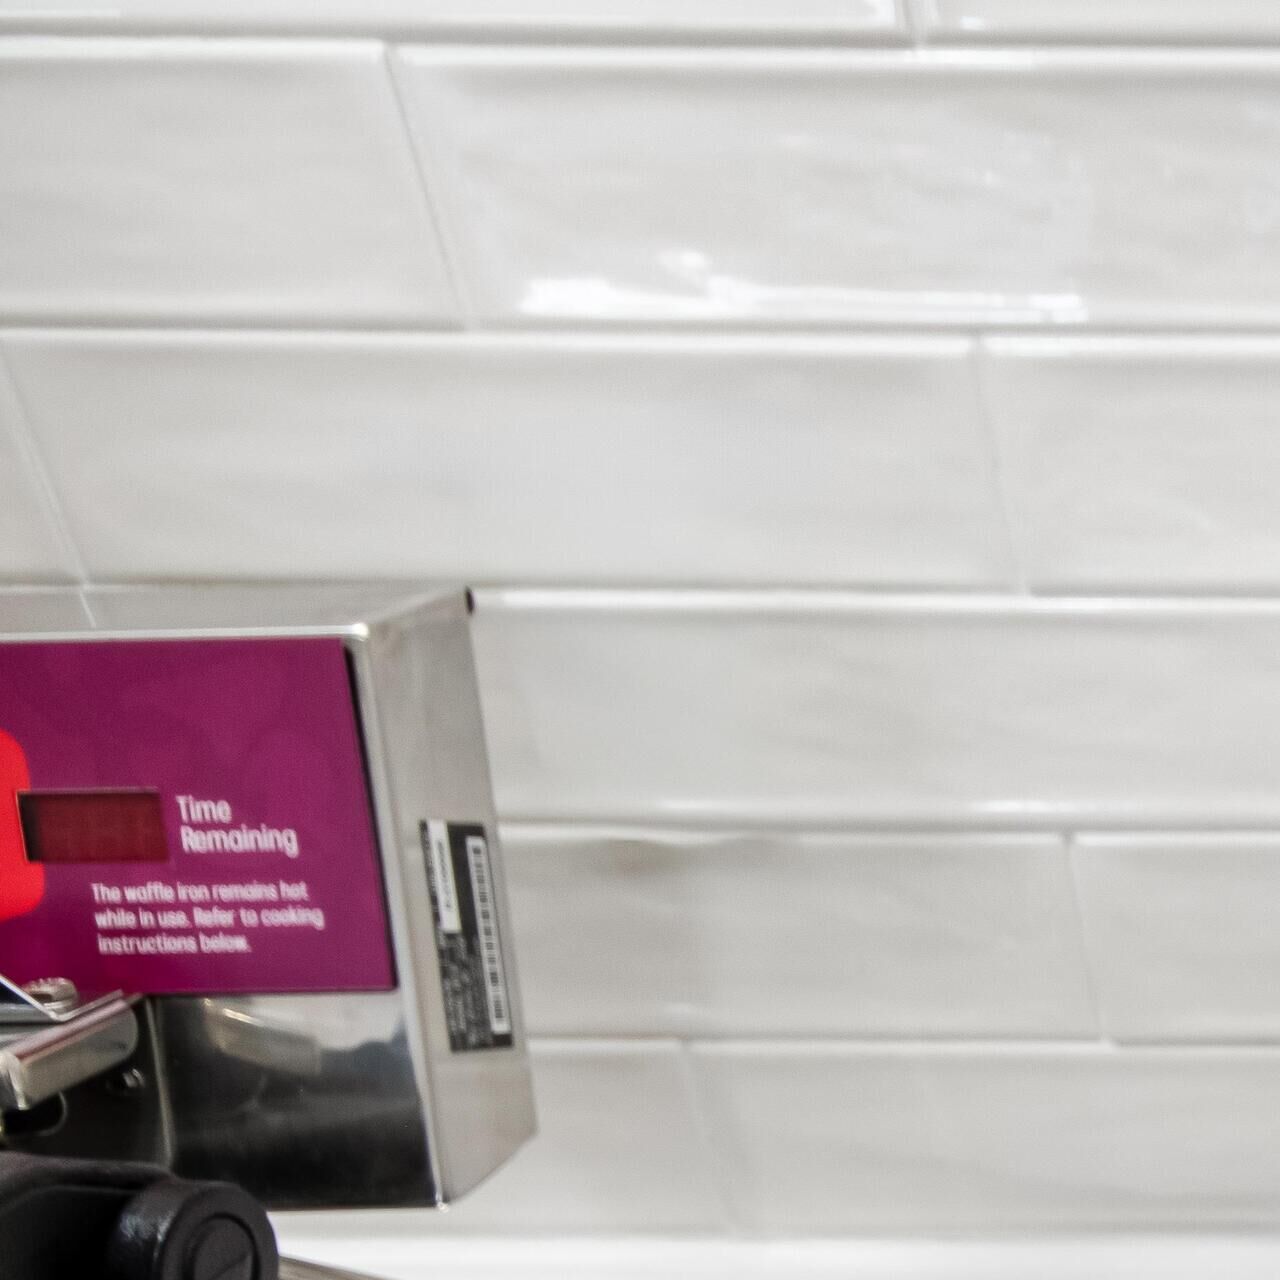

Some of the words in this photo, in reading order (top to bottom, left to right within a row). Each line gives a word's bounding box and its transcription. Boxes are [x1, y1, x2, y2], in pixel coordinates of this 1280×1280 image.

[175, 795, 232, 823] Time
[180, 824, 299, 858] Remaining
[91, 883, 122, 903] The
[124, 881, 175, 903] waffle
[177, 881, 210, 902] iron
[212, 880, 278, 901] remains
[279, 880, 309, 901] hot
[95, 907, 136, 929] while
[138, 908, 153, 928] in
[193, 906, 236, 928] Refer
[240, 908, 258, 928] to
[261, 906, 325, 931] cooking
[97, 933, 197, 954] instructions
